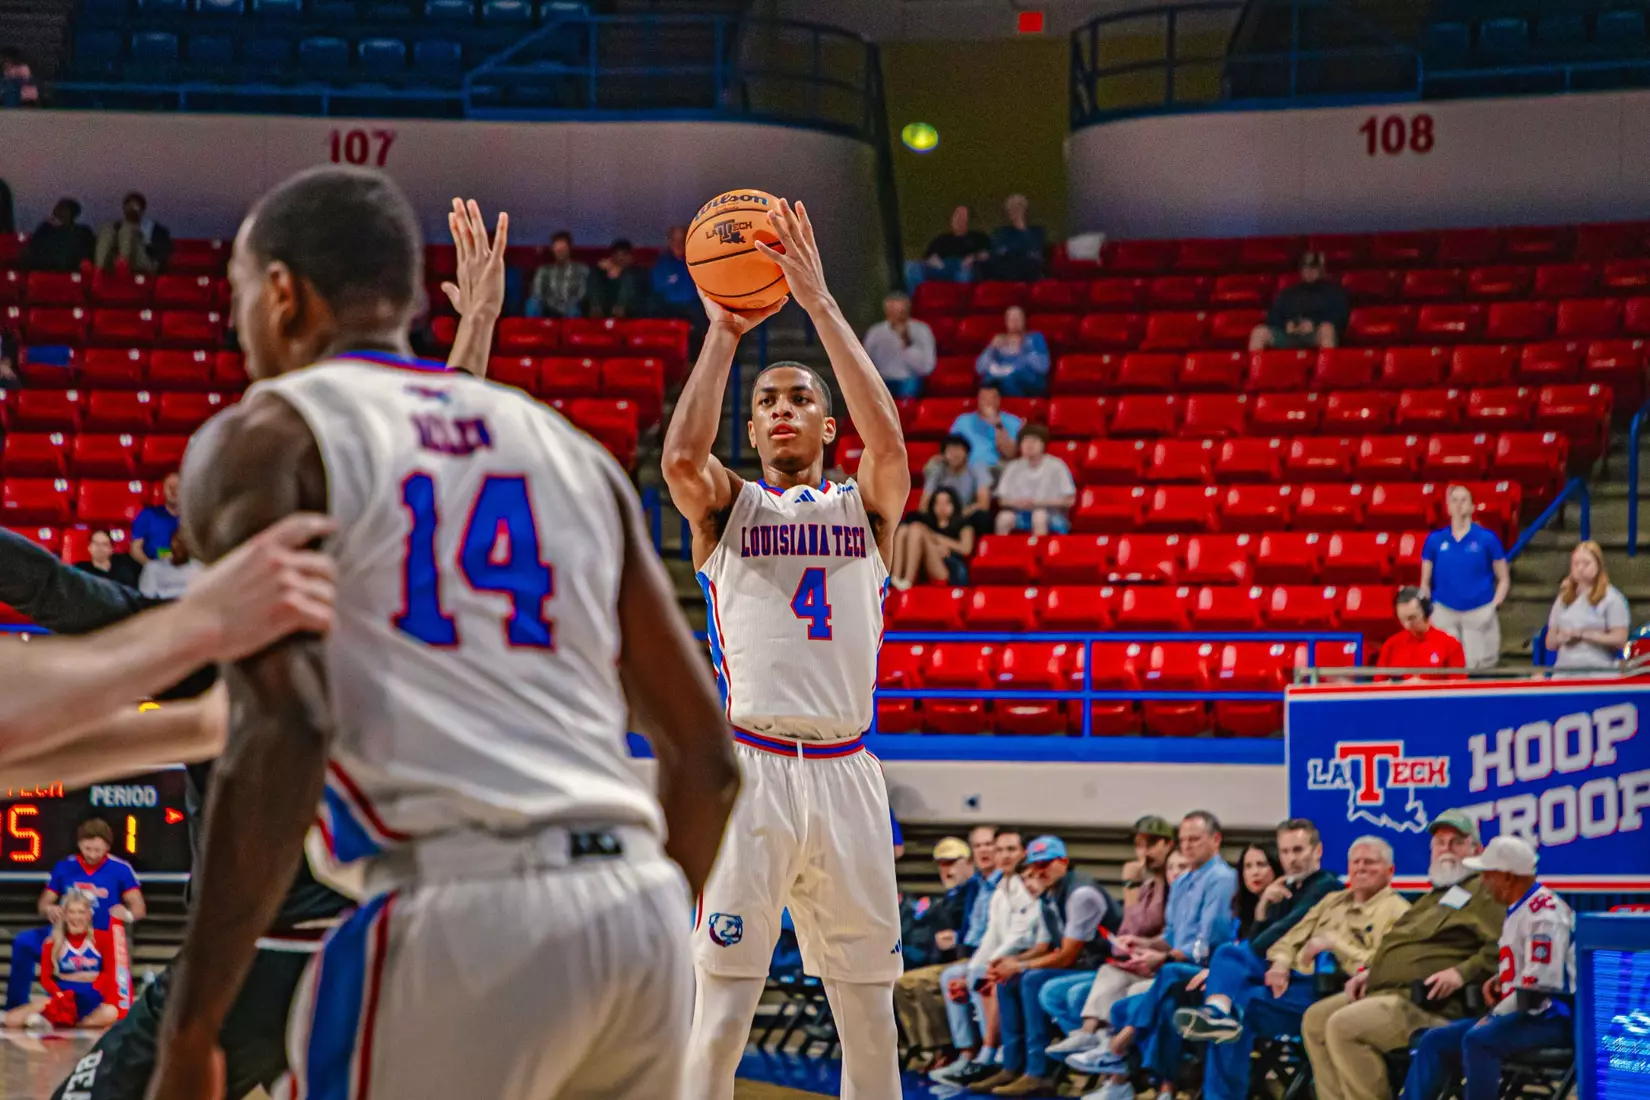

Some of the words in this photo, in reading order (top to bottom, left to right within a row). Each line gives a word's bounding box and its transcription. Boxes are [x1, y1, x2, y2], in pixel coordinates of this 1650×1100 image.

[329, 128, 397, 167] 107
[1359, 113, 1434, 157] 108
[390, 470, 557, 649] 14
[740, 523, 831, 559] LOUISIANA
[790, 567, 833, 641] 4
[1468, 702, 1638, 793] HOOP
[90, 783, 160, 808] PERIOD
[0, 804, 41, 862] 5
[125, 814, 138, 854] 1
